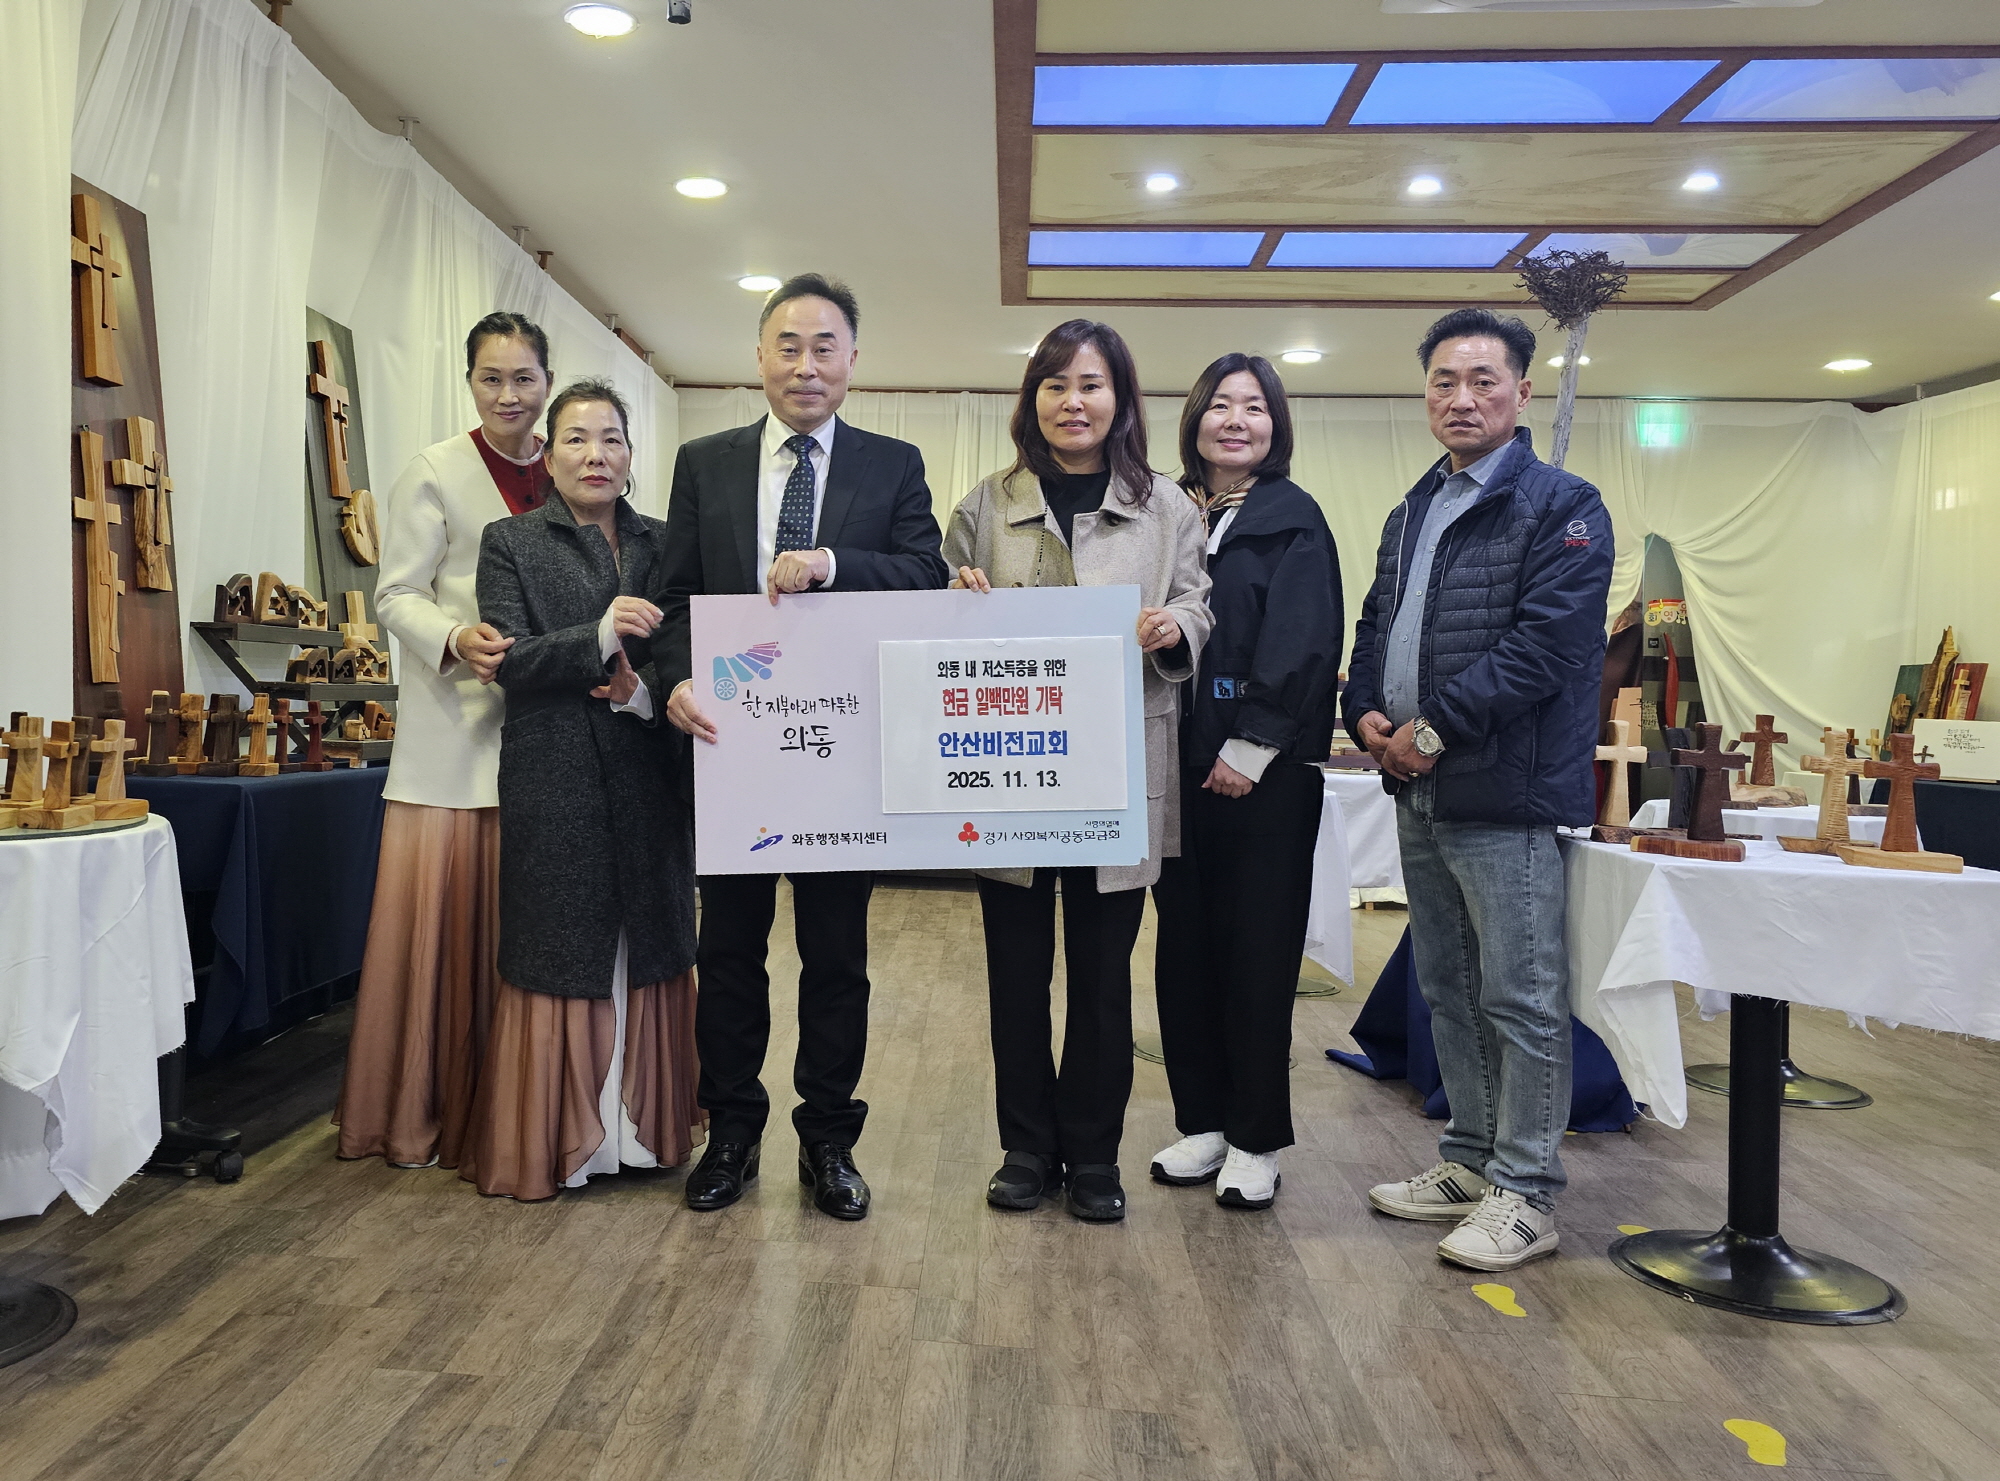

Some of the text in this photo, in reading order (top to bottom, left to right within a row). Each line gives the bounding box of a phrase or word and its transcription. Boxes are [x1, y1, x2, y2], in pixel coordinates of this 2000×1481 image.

[1564, 539, 1591, 547] PEAK
[937, 659, 1066, 678] 와동 내 저소득층을 위한
[742, 689, 762, 718] 한
[818, 692, 860, 715] 따뜻한
[942, 685, 1063, 716] 현금 일백만원 기탁
[779, 725, 837, 758] 와동
[938, 730, 1068, 757] 안산비전교회
[947, 770, 1061, 788] 2025. 11. 13.
[791, 831, 887, 846] 와동행정복지센터
[983, 829, 1120, 845] 경기 사회복지공동모금회
